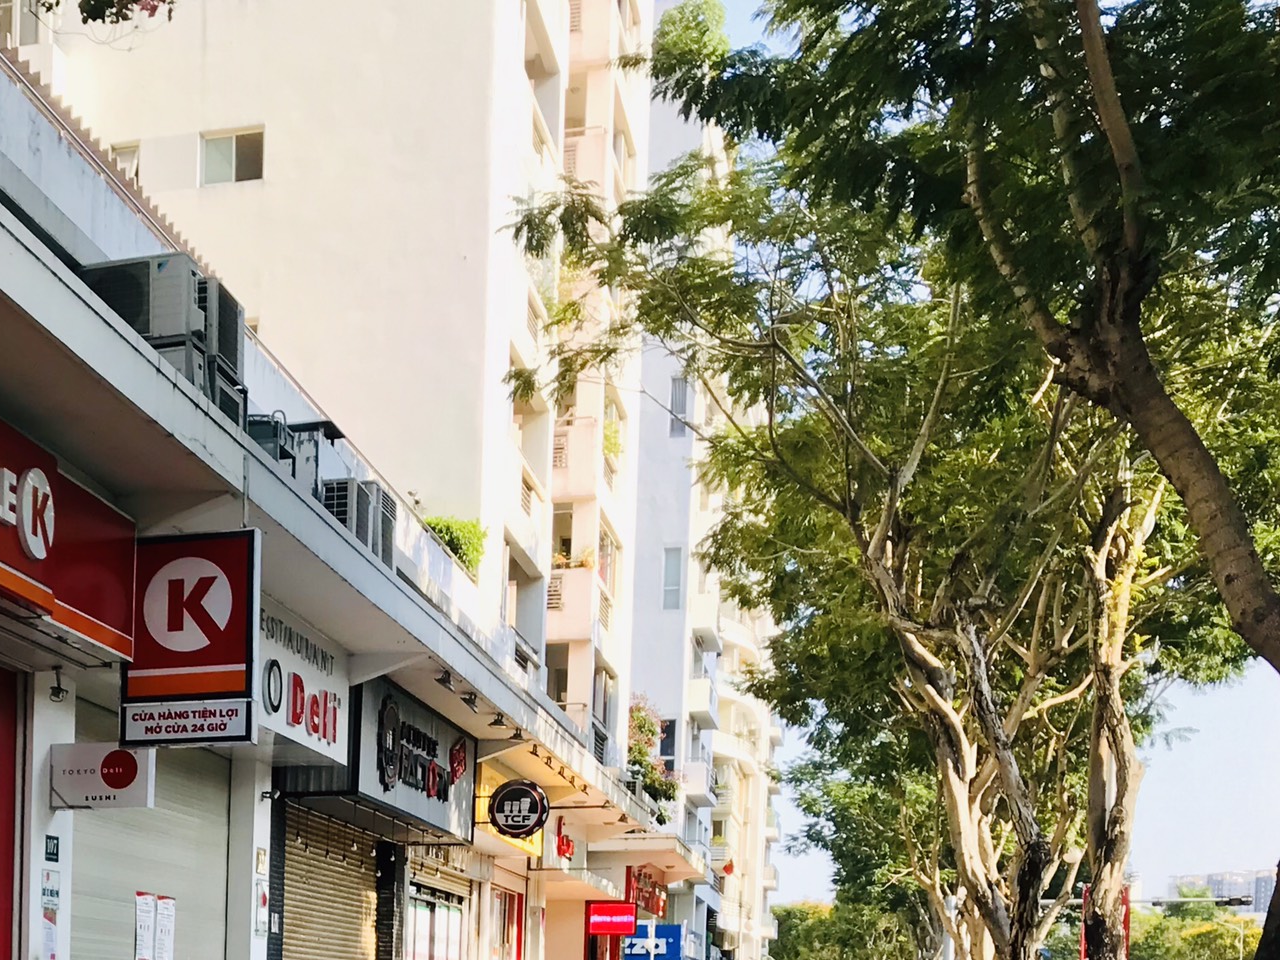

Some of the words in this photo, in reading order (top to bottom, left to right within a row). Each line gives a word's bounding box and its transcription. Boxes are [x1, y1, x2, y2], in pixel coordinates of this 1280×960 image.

[259, 608, 335, 677] ESTAURANT
[131, 709, 156, 722] CỬA
[157, 707, 190, 721] HÀNG
[190, 706, 217, 721] TIỆN
[219, 708, 239, 721] LỢI
[286, 671, 338, 746] Deli
[144, 722, 163, 735] MỞ
[164, 721, 189, 734] CỬA
[191, 722, 205, 733] 24
[206, 720, 228, 732] GIỜ
[62, 768, 96, 776] TOKYO
[85, 794, 117, 802] SUSHI
[503, 815, 531, 823] TCF
[624, 938, 667, 954] zza
